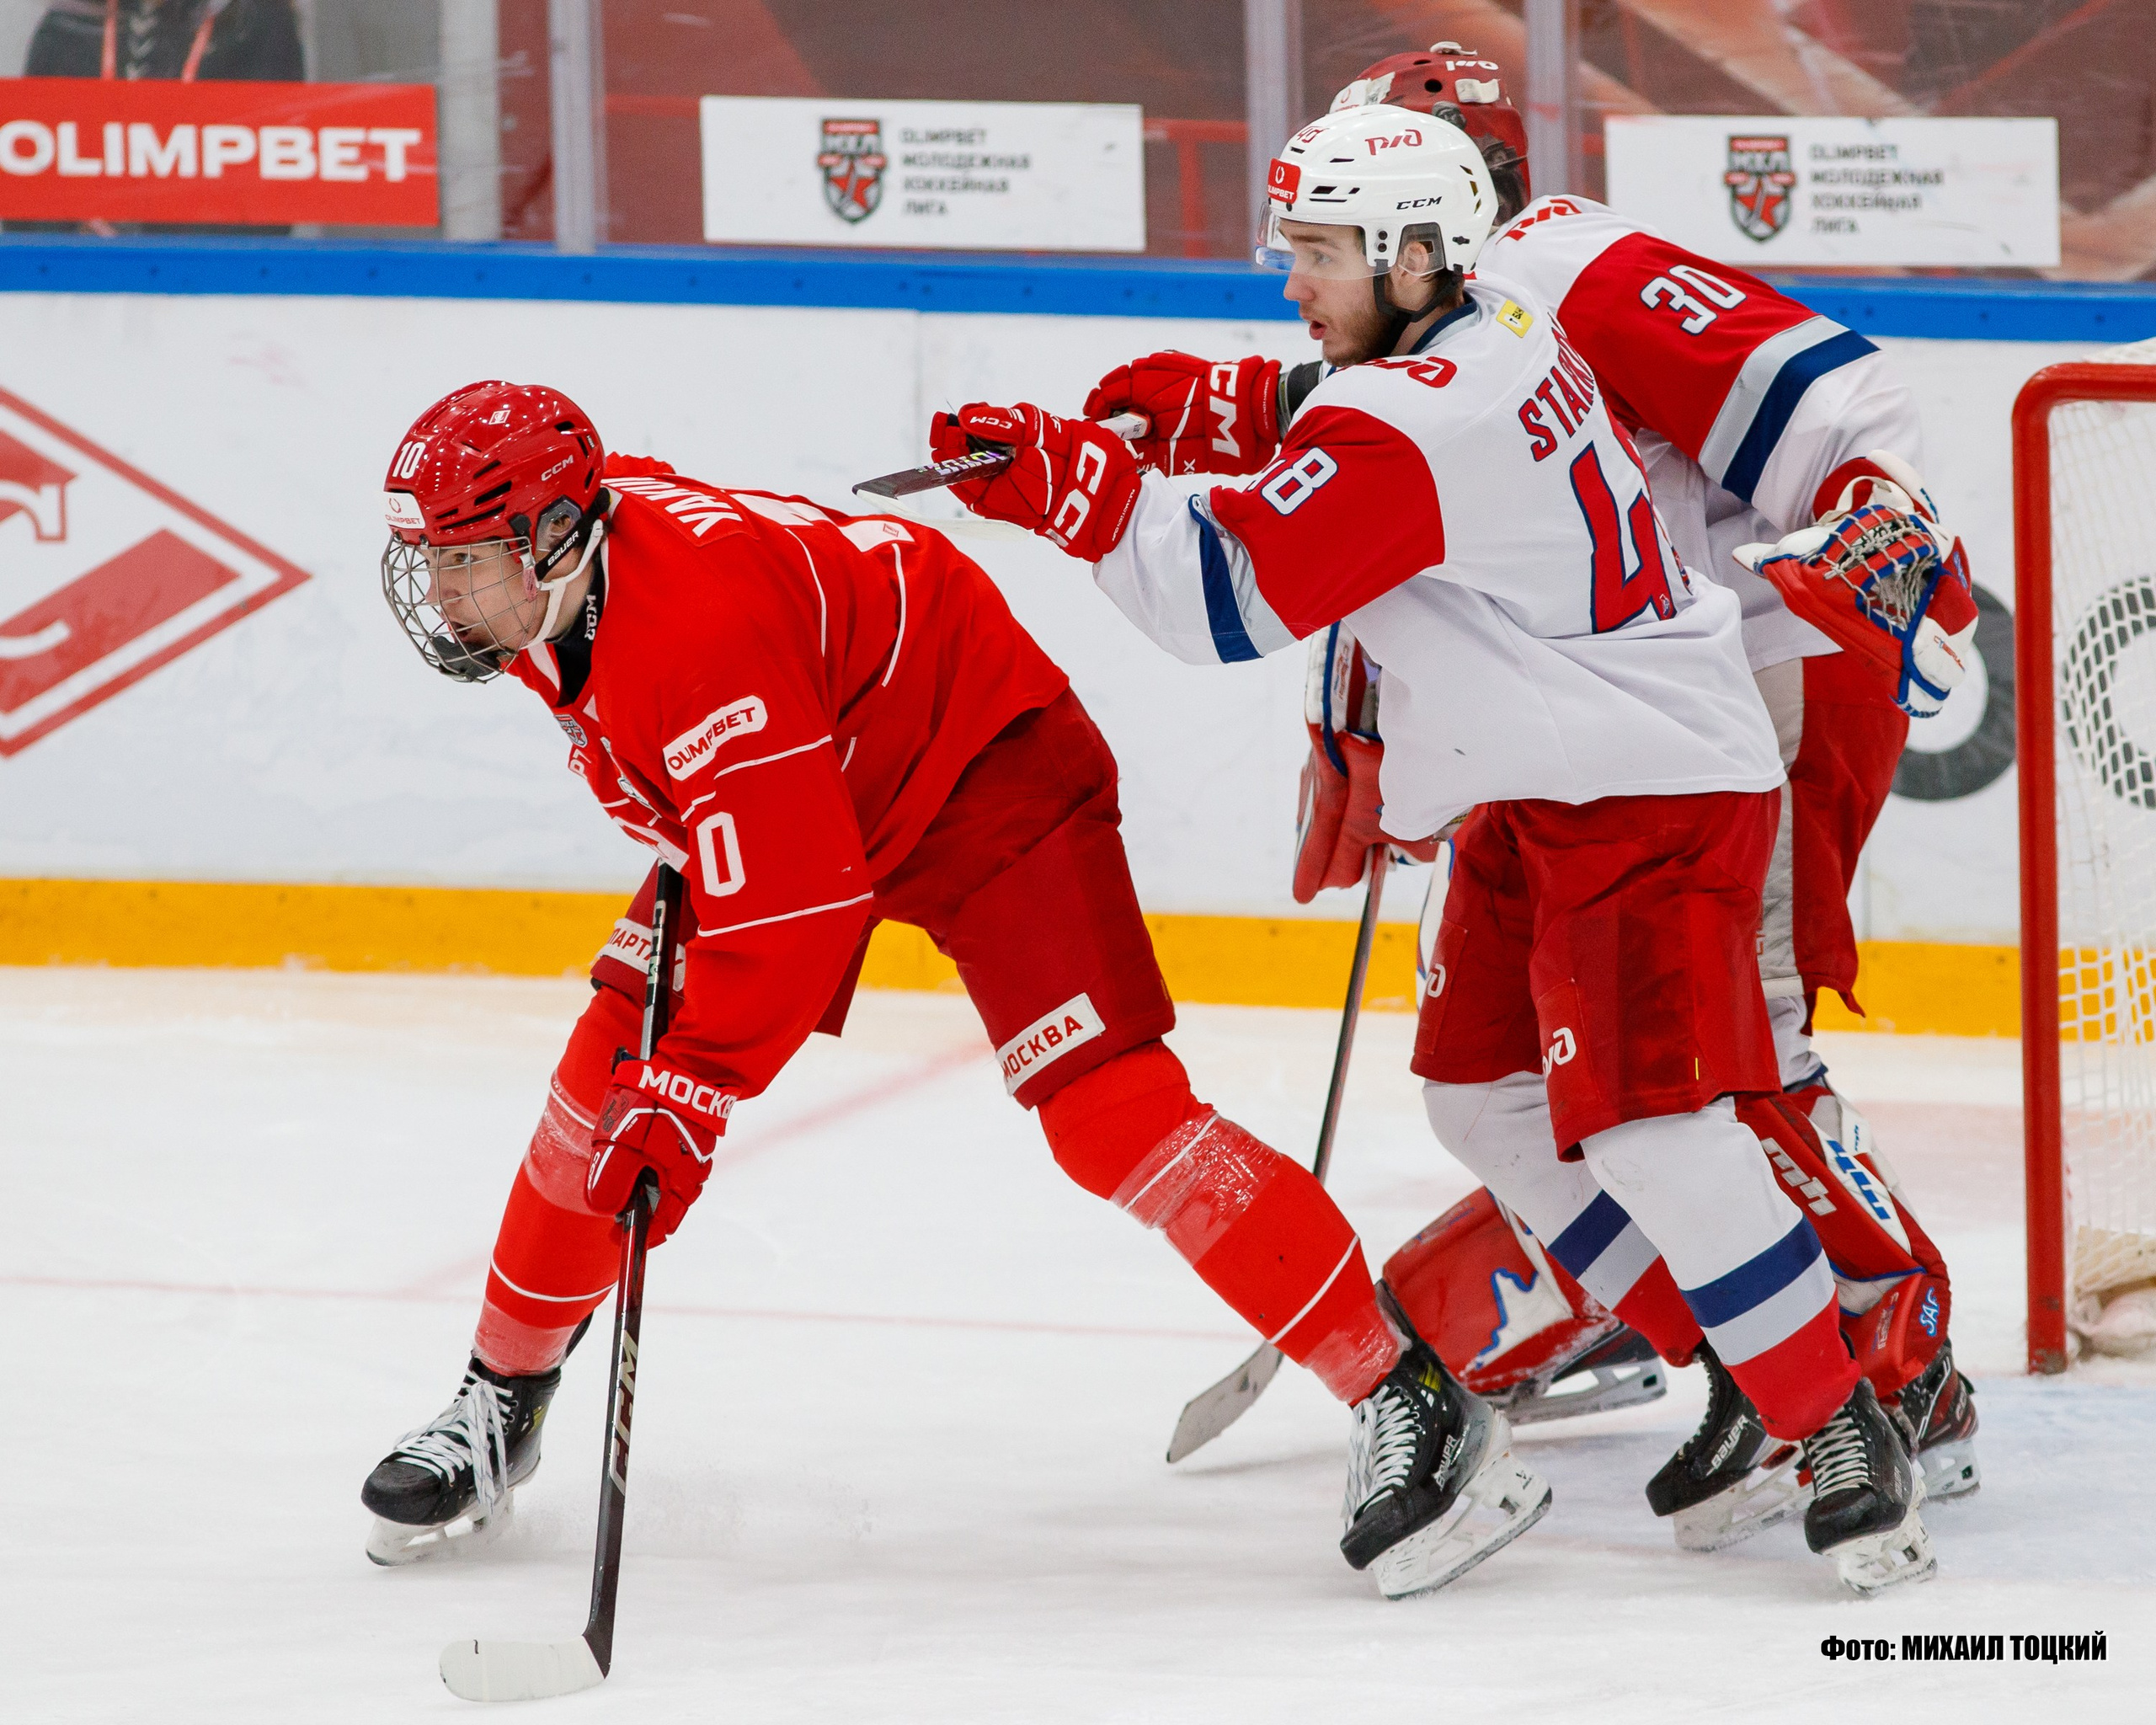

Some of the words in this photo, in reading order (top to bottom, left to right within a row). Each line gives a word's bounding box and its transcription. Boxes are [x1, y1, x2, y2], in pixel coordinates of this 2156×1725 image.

[0, 120, 421, 182] OLIMPBET
[1396, 195, 1443, 211] CCM
[1639, 264, 1747, 335] 30
[970, 416, 1012, 430] CCM
[1209, 362, 1241, 458] CM
[392, 441, 425, 479] 10
[541, 455, 574, 482] CCM
[385, 514, 420, 525] OLIMPBET
[1570, 413, 1688, 634] 4
[547, 531, 579, 567] BAUER
[667, 706, 755, 771] OLIMPBET
[610, 1329, 638, 1497] CCM
[1710, 1414, 1749, 1470] BAUER
